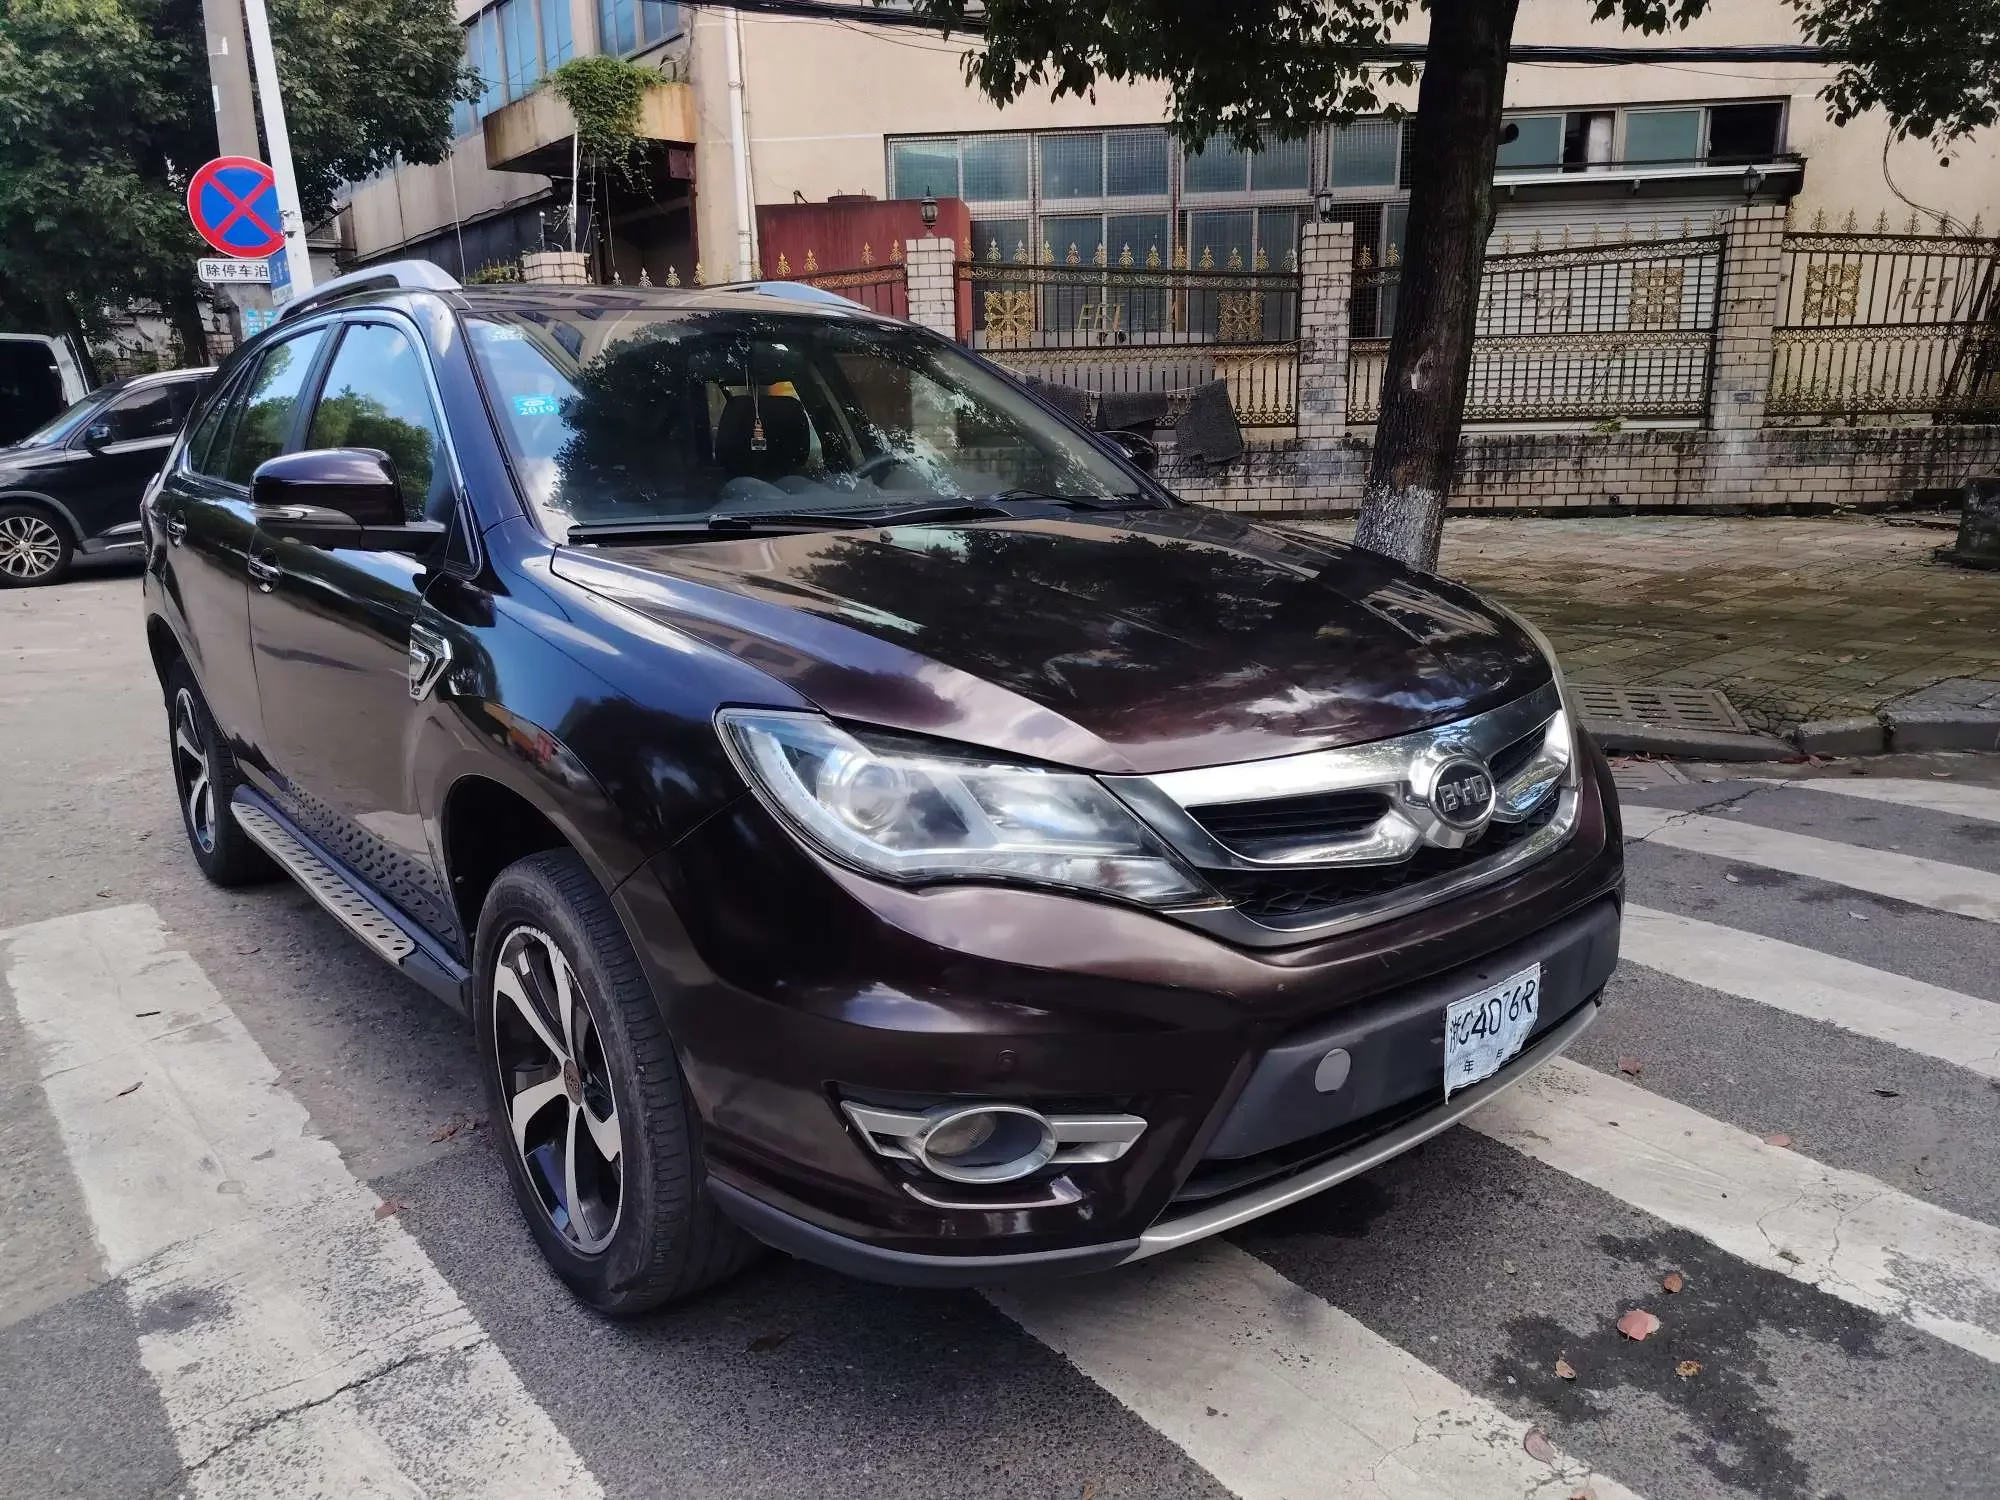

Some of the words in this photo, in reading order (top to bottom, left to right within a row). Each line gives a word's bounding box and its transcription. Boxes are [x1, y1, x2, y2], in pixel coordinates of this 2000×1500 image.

[206, 264, 268, 277] 除停车泊
[1893, 277, 1953, 310] FEI
[1438, 774, 1490, 812] BYD
